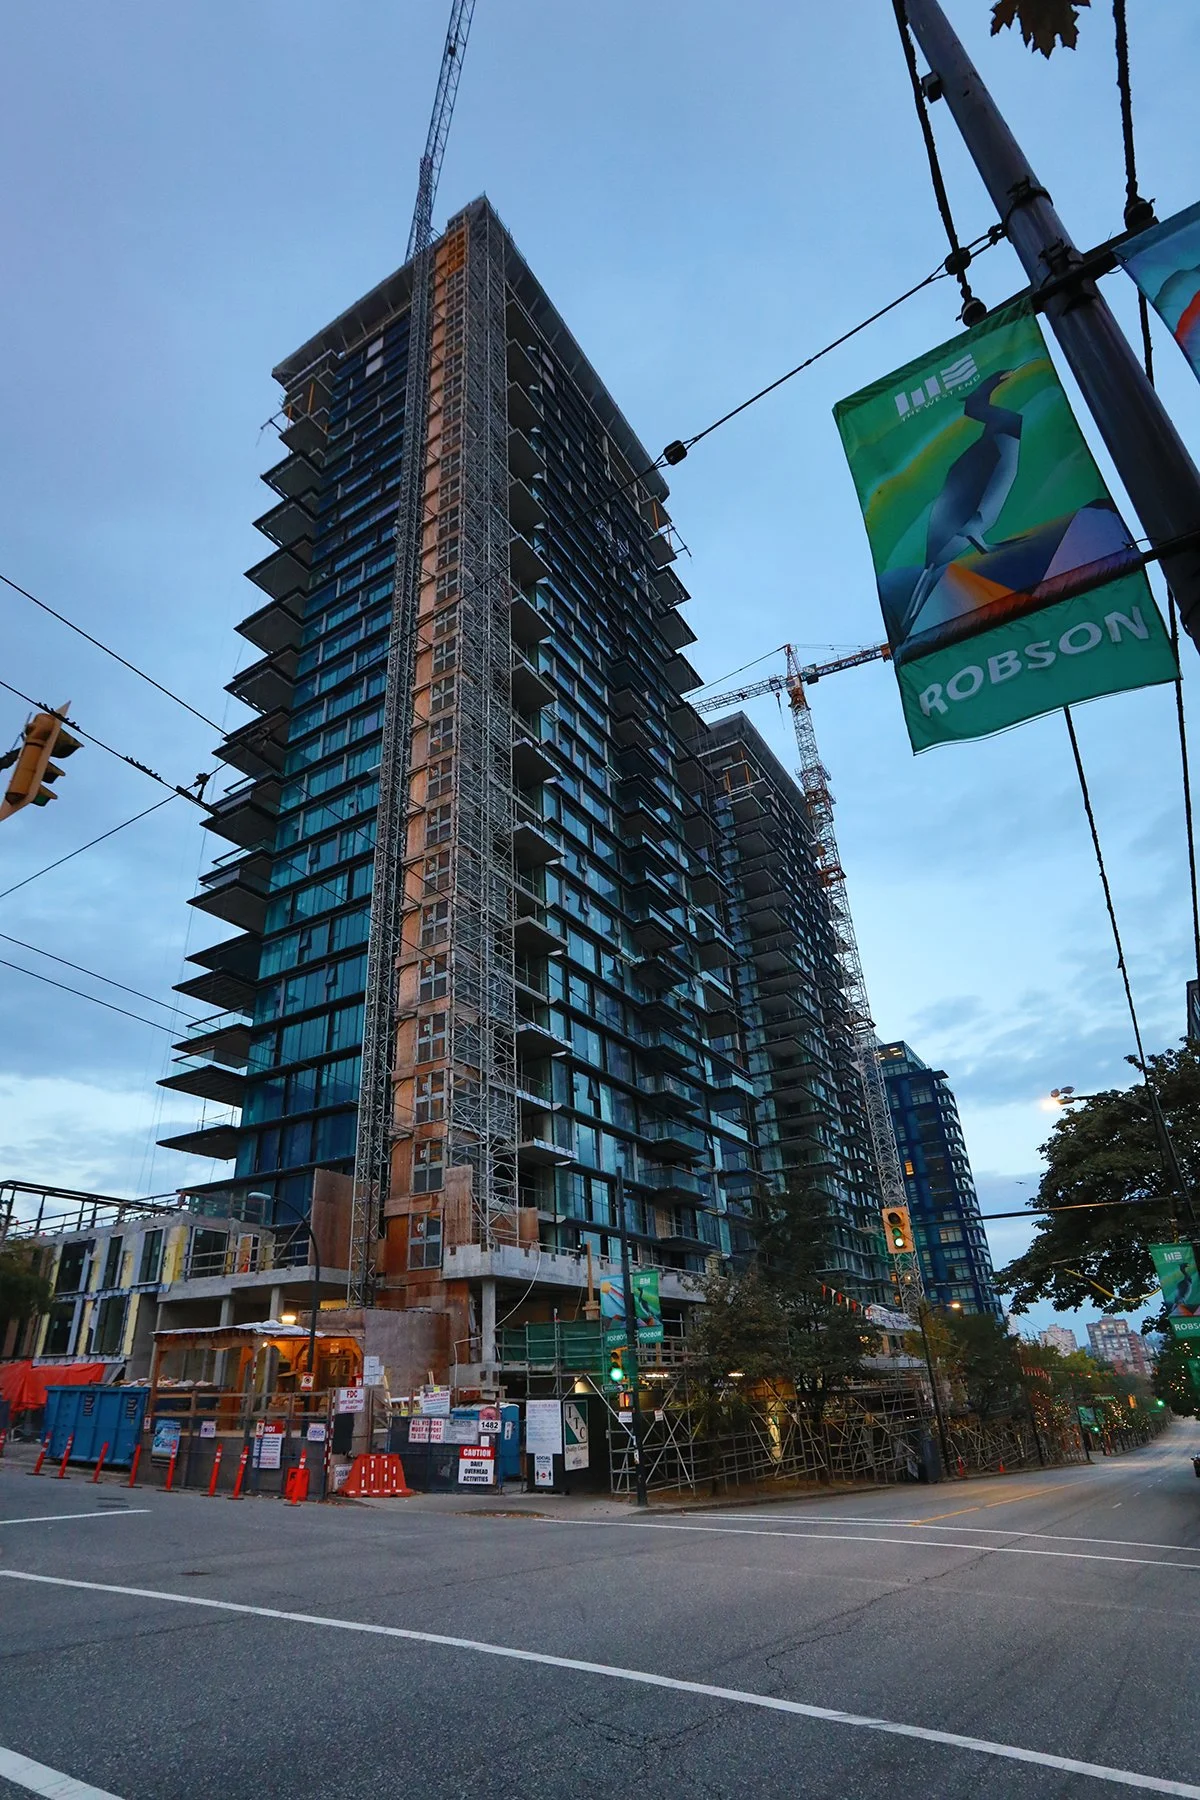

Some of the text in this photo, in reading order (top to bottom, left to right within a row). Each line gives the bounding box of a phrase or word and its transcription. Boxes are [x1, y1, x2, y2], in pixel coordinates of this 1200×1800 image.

[924, 390, 953, 408] WEST
[958, 374, 981, 391] END
[918, 606, 1150, 718] ROBSON
[1174, 1322, 1200, 1331] ROBS
[464, 1448, 492, 1457] CAUTION
